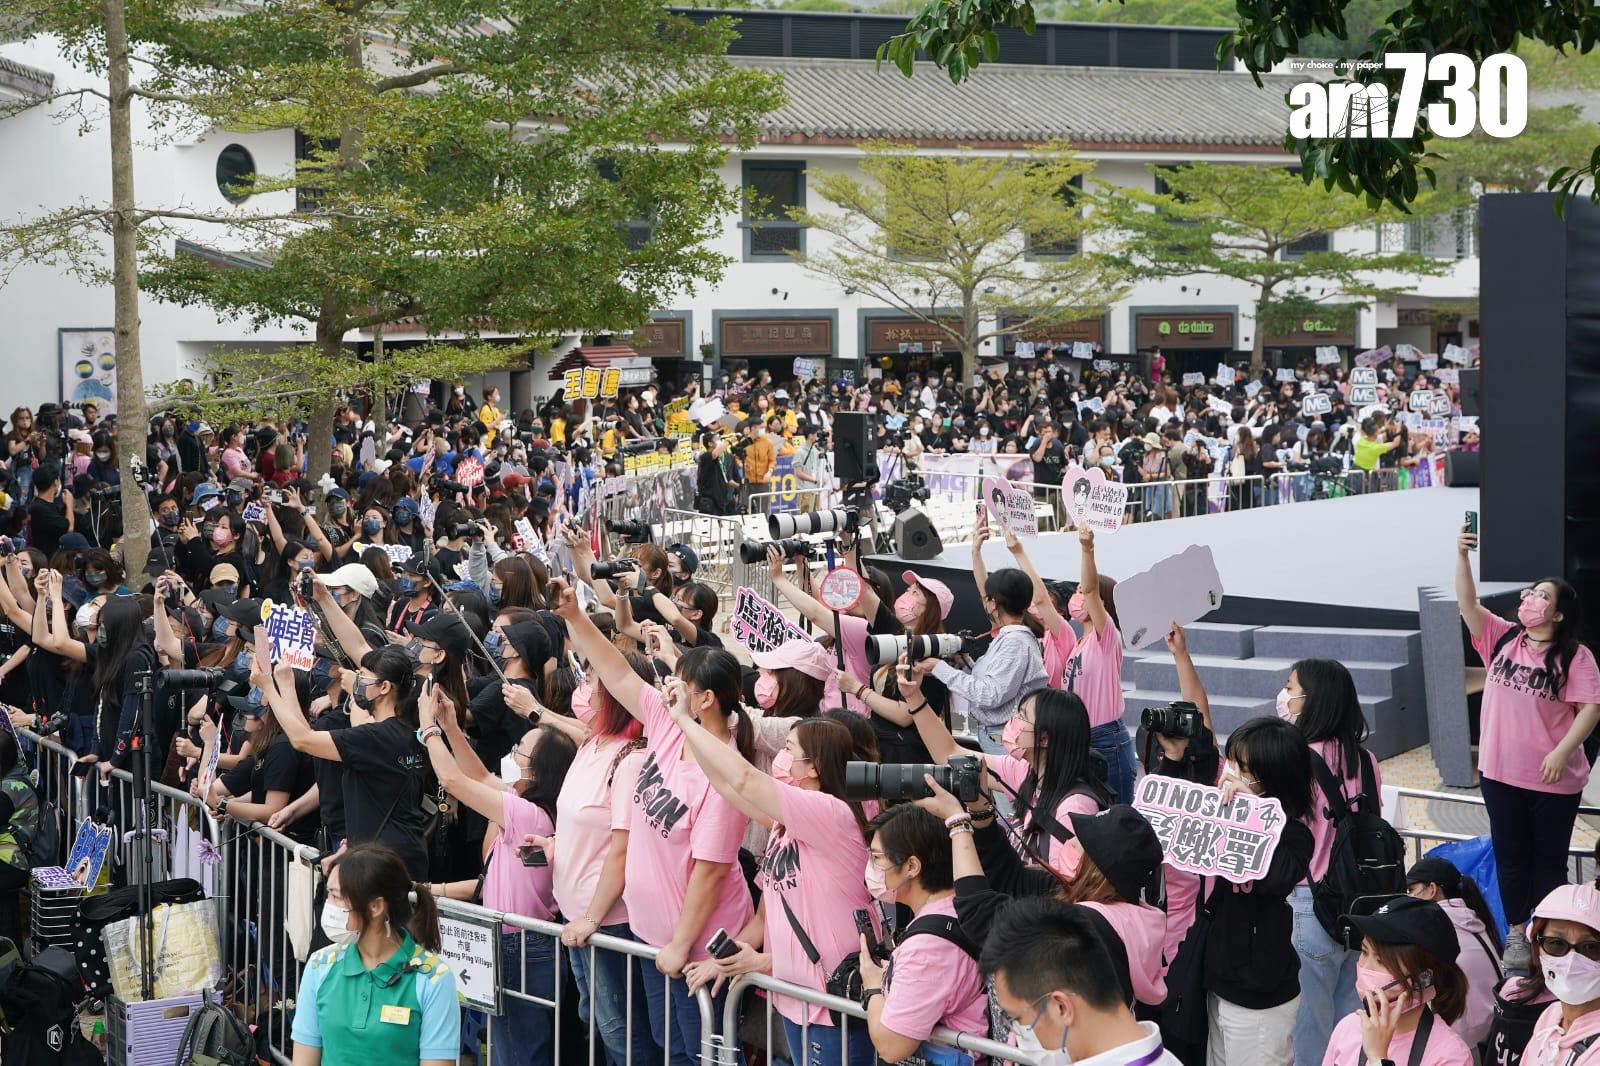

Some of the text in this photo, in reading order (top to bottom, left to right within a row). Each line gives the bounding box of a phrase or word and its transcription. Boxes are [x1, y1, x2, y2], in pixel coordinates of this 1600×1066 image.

[737, 592, 803, 648] 盧瀚
[461, 952, 474, 964] Ping
[474, 955, 493, 969] Village
